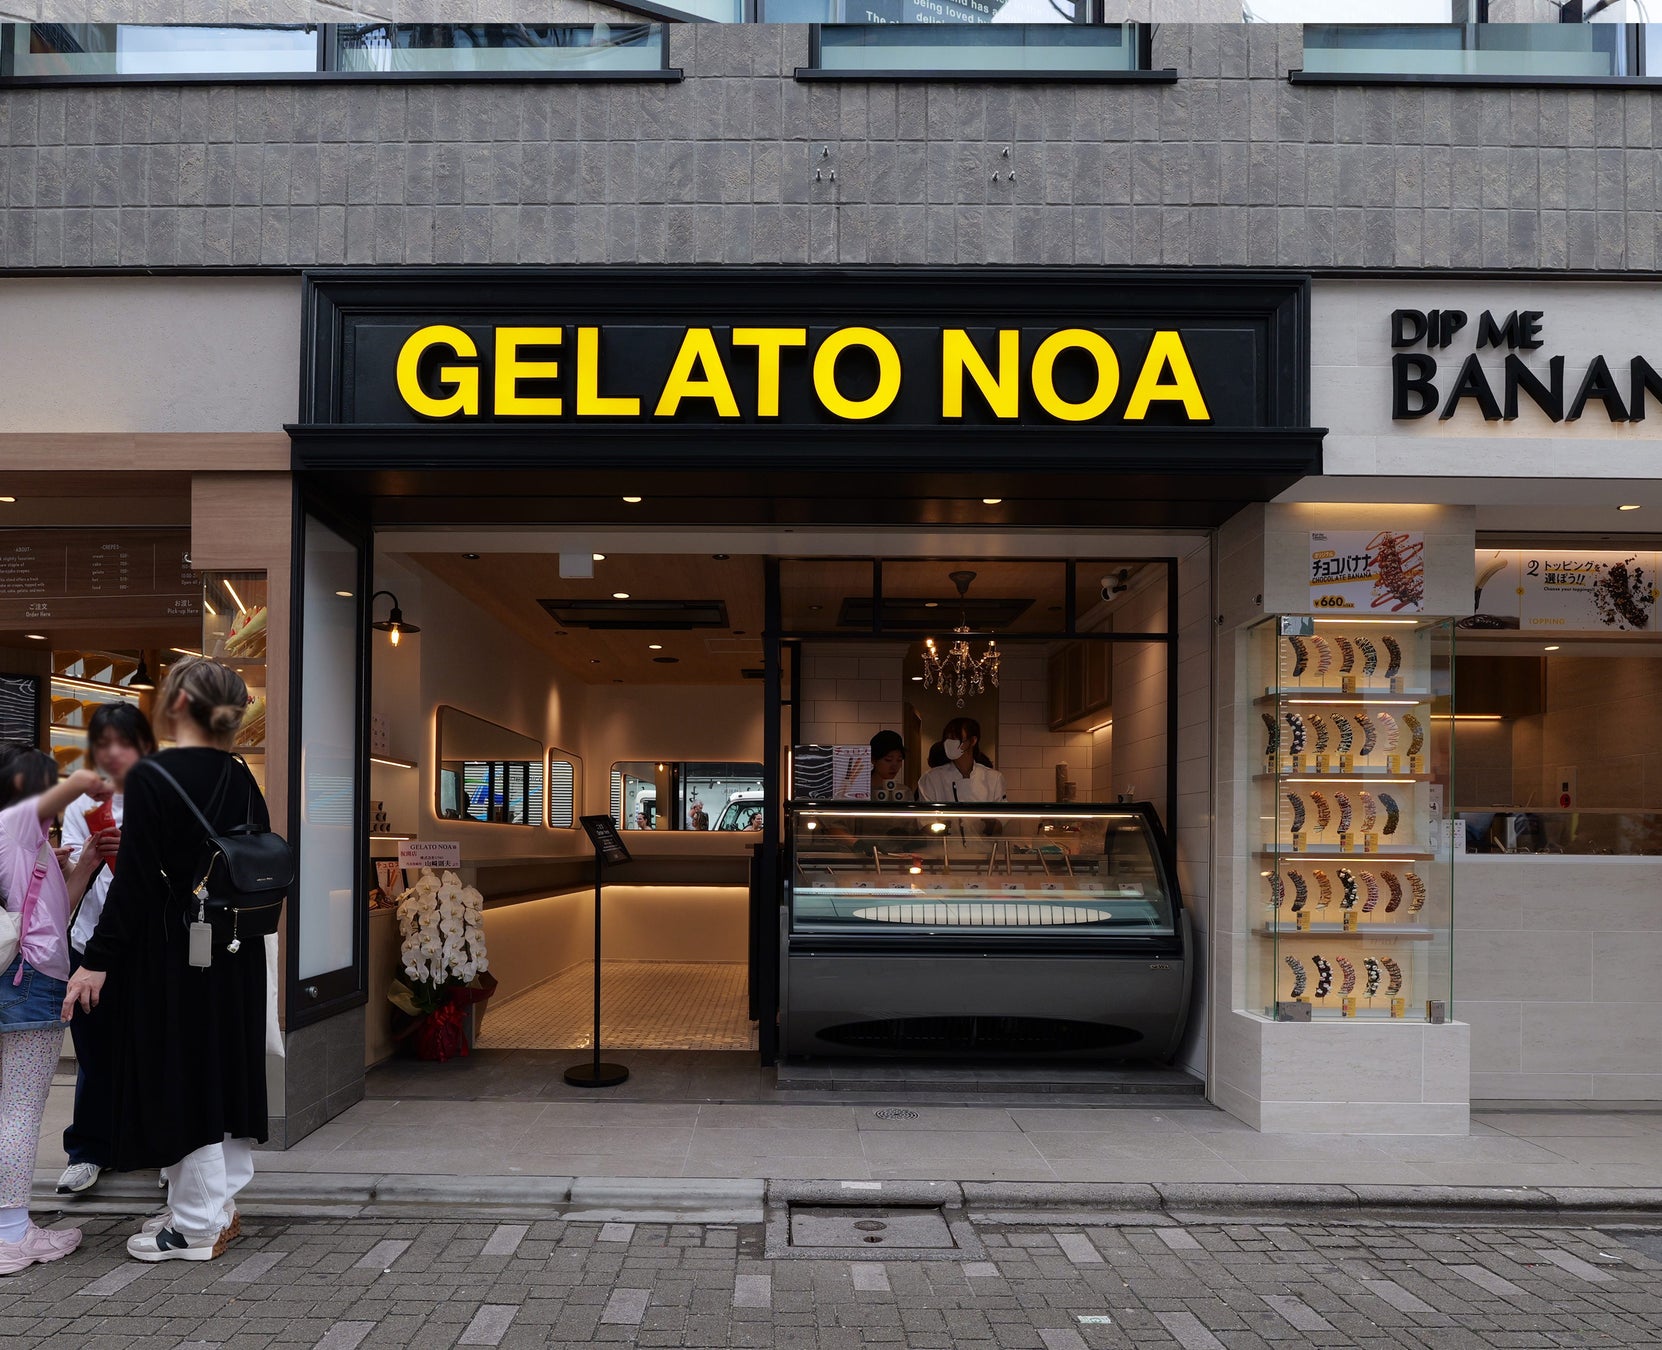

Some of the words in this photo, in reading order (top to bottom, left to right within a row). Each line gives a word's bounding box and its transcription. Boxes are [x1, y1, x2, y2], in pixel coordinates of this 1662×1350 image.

[865, 10, 887, 23] The
[946, 6, 974, 23] loved
[1391, 309, 1468, 348] DIP
[1476, 309, 1544, 350] ME
[397, 325, 901, 421] GELATO
[943, 327, 1210, 421] NOA
[1312, 554, 1372, 577] チョコバナナ
[1527, 559, 1540, 577] 2
[1544, 560, 1601, 573] トッピングを
[1312, 573, 1347, 584] CHOCOLATE
[1347, 571, 1372, 580] BANANA
[174, 599, 193, 607] お渡し
